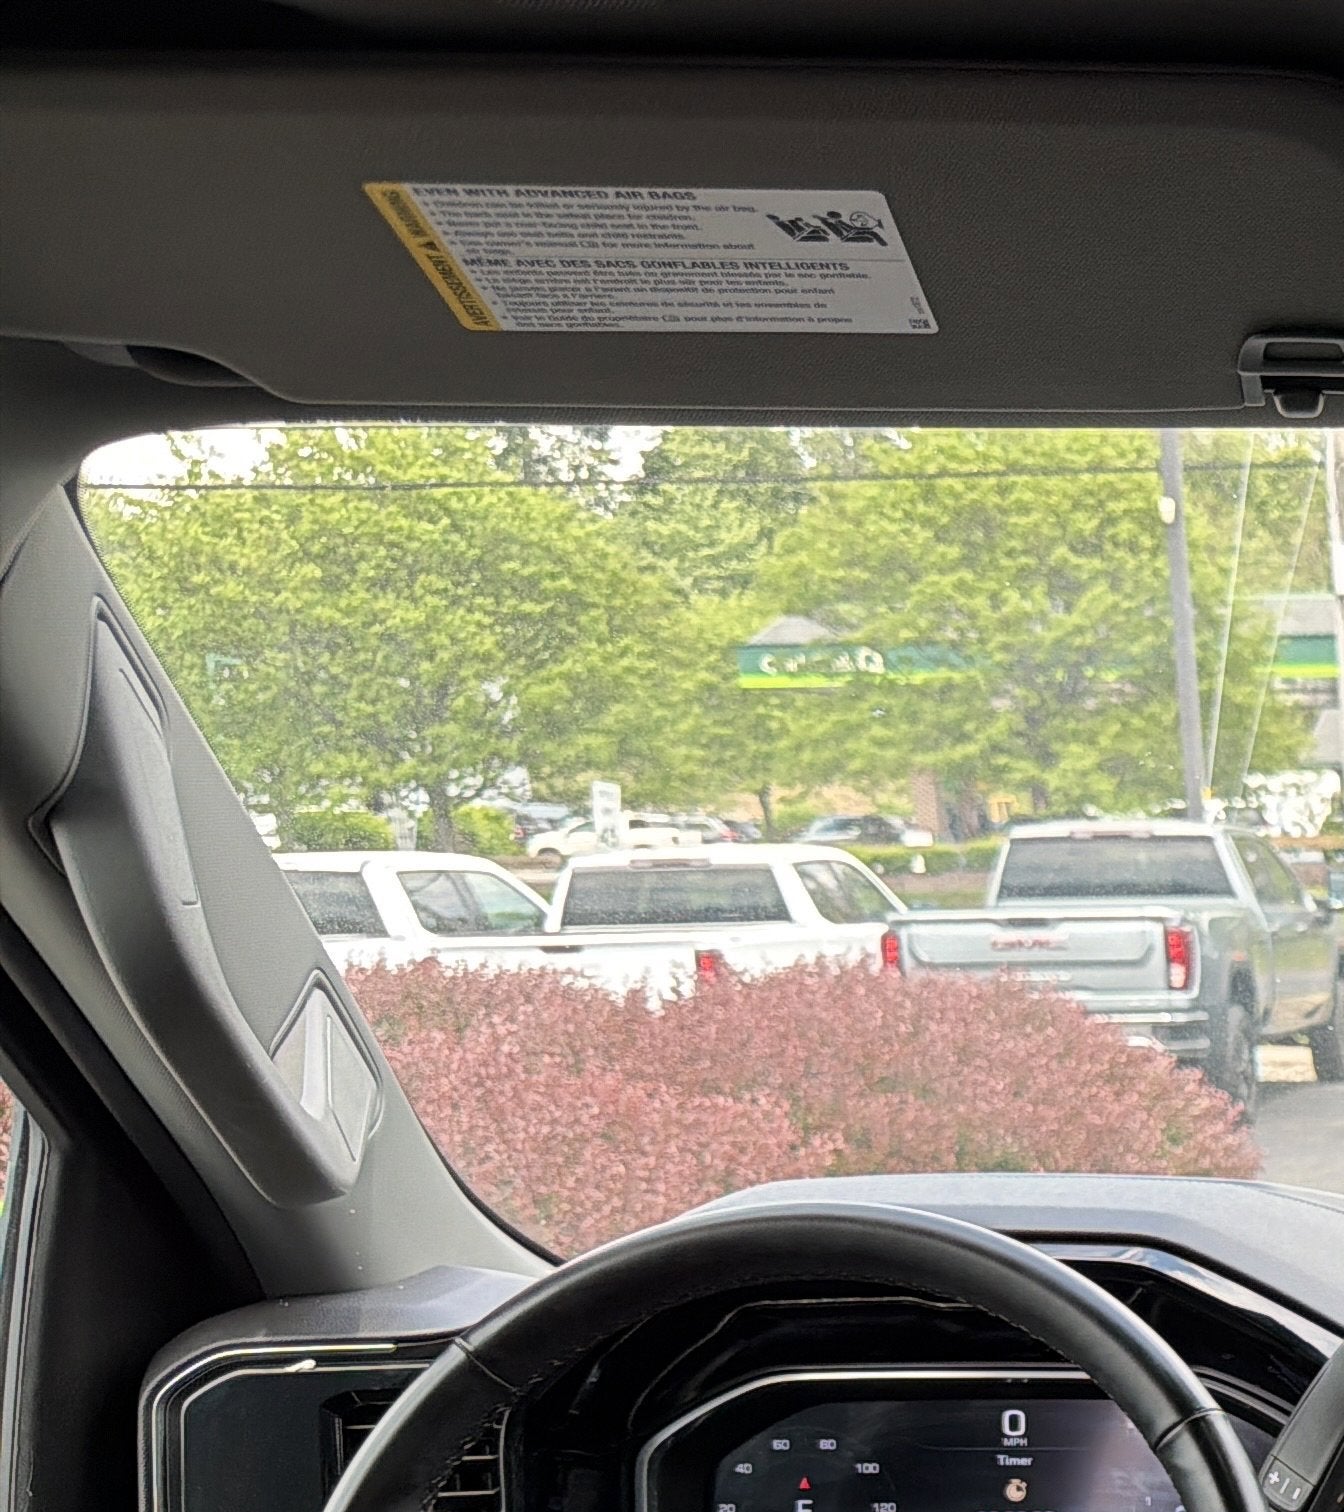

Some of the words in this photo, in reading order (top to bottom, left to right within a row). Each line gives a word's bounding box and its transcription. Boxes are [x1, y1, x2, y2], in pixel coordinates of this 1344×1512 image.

[559, 260, 592, 268] DES
[594, 260, 638, 269] SACS
[1002, 1409, 1026, 1437] 0
[1003, 1437, 1028, 1447] MPH
[996, 1454, 1034, 1467] Timer
[735, 1463, 752, 1474] 40
[855, 1463, 880, 1474] 100
